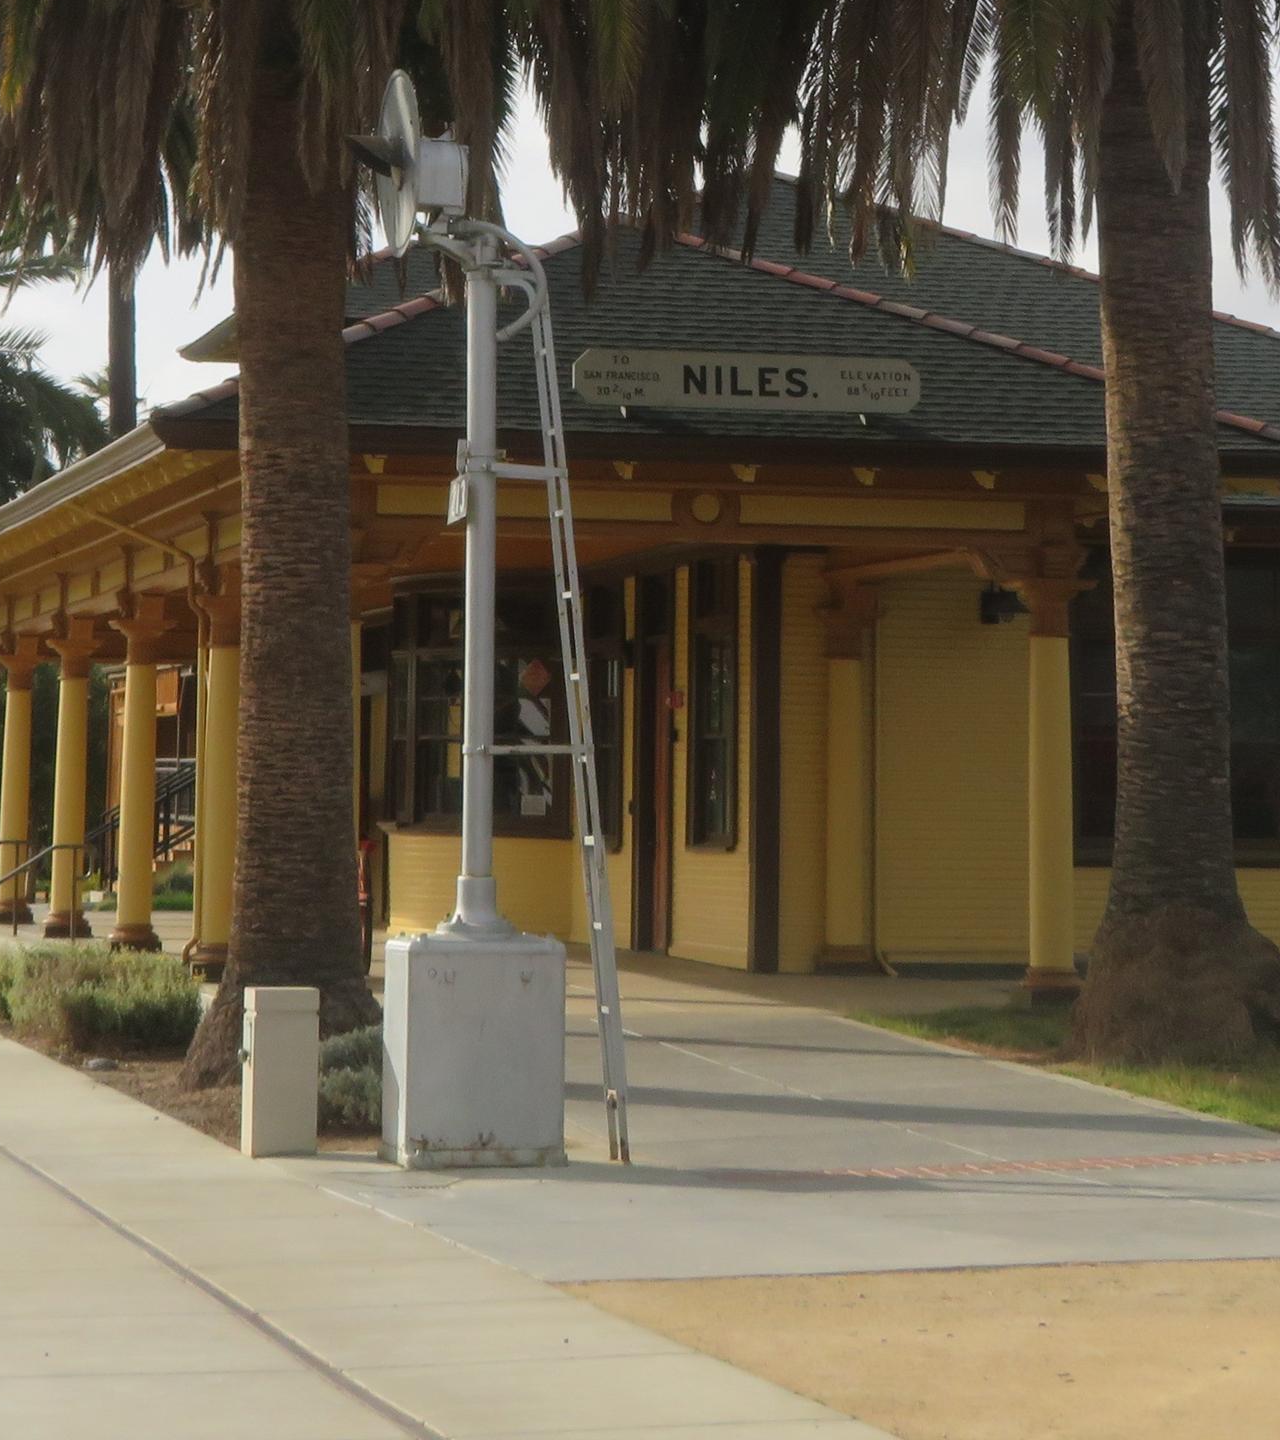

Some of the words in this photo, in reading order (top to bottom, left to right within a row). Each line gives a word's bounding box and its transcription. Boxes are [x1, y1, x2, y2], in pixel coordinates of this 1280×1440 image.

[613, 354, 630, 365] TO
[583, 370, 602, 379] SAN
[840, 370, 911, 382] ELEVATION
[683, 365, 818, 398] NILES.
